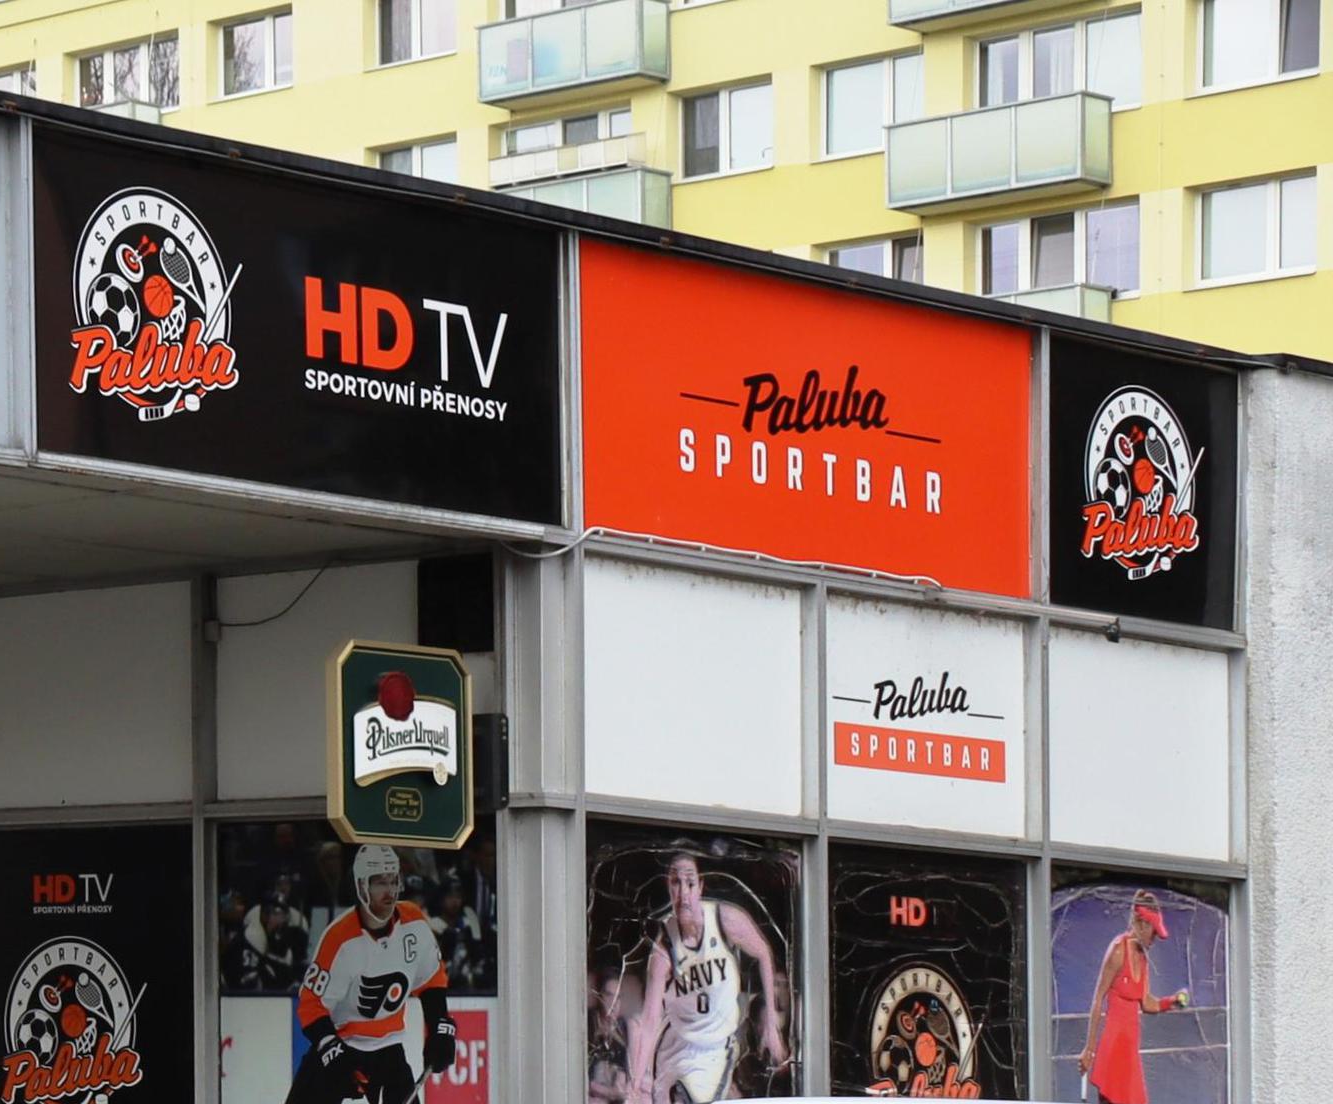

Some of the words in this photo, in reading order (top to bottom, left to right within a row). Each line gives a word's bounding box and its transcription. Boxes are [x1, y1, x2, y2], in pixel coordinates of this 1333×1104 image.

[94, 199, 210, 266] SPORTBAR
[69, 317, 239, 394] Paluba
[304, 276, 414, 371] HD
[423, 299, 507, 389] TV
[304, 369, 414, 407] SPORTOVNÍ
[420, 383, 507, 422] PŘENOSY
[743, 365, 889, 439] Paluba
[1099, 396, 1182, 450] SPORTBAR
[679, 427, 943, 516] SPORTBAR
[1081, 498, 1199, 561] Paluba
[873, 671, 969, 721] Paluba
[366, 716, 414, 761] Pilsner
[414, 718, 450, 756] Urquell
[850, 732, 991, 773] SPORTBAR
[34, 875, 76, 902] HD
[78, 873, 113, 902] TV
[890, 895, 927, 927] HD
[21, 947, 118, 990] SPORTBAR
[403, 933, 418, 964] C
[304, 961, 332, 997] 28
[673, 957, 727, 998] NAVY
[880, 972, 963, 1018] SPORTBAR
[697, 991, 710, 1014] 0
[0, 1033, 143, 1104] Paluba
[321, 1042, 346, 1067] STX
